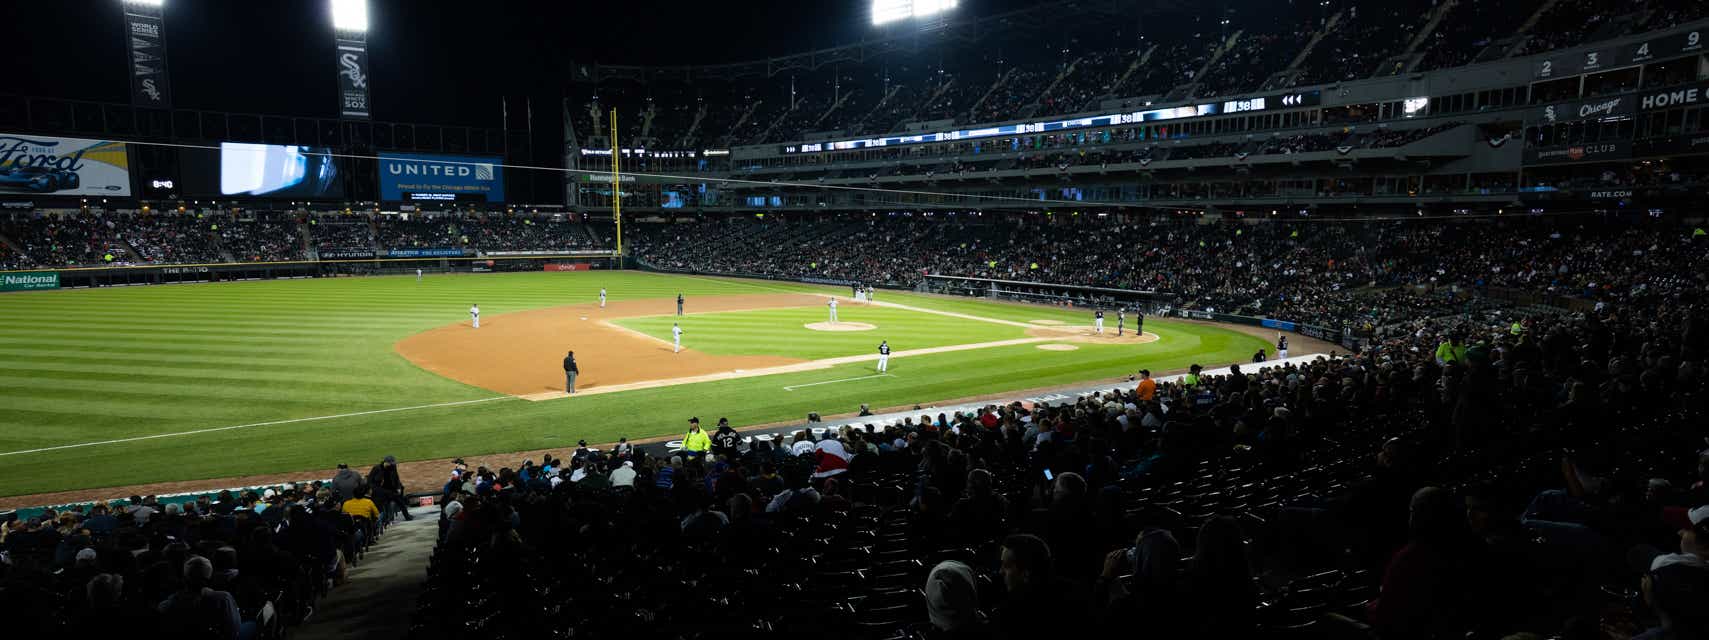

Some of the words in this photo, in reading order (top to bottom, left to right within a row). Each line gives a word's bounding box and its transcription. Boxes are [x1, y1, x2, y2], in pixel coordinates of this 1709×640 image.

[131, 22, 158, 30] WORLD
[1688, 32, 1699, 46] 9
[1637, 43, 1649, 56] 4
[1587, 53, 1598, 65] 3
[1543, 61, 1552, 73] 2
[344, 101, 366, 109] SOX
[1641, 88, 1698, 110] HOME
[1236, 100, 1251, 111] 38
[1579, 97, 1622, 117] Chicago
[0, 137, 84, 172] Ford
[1585, 144, 1616, 154] CLUB
[389, 163, 471, 177] UNITED
[5, 275, 57, 285] National
[723, 437, 733, 448] 12
